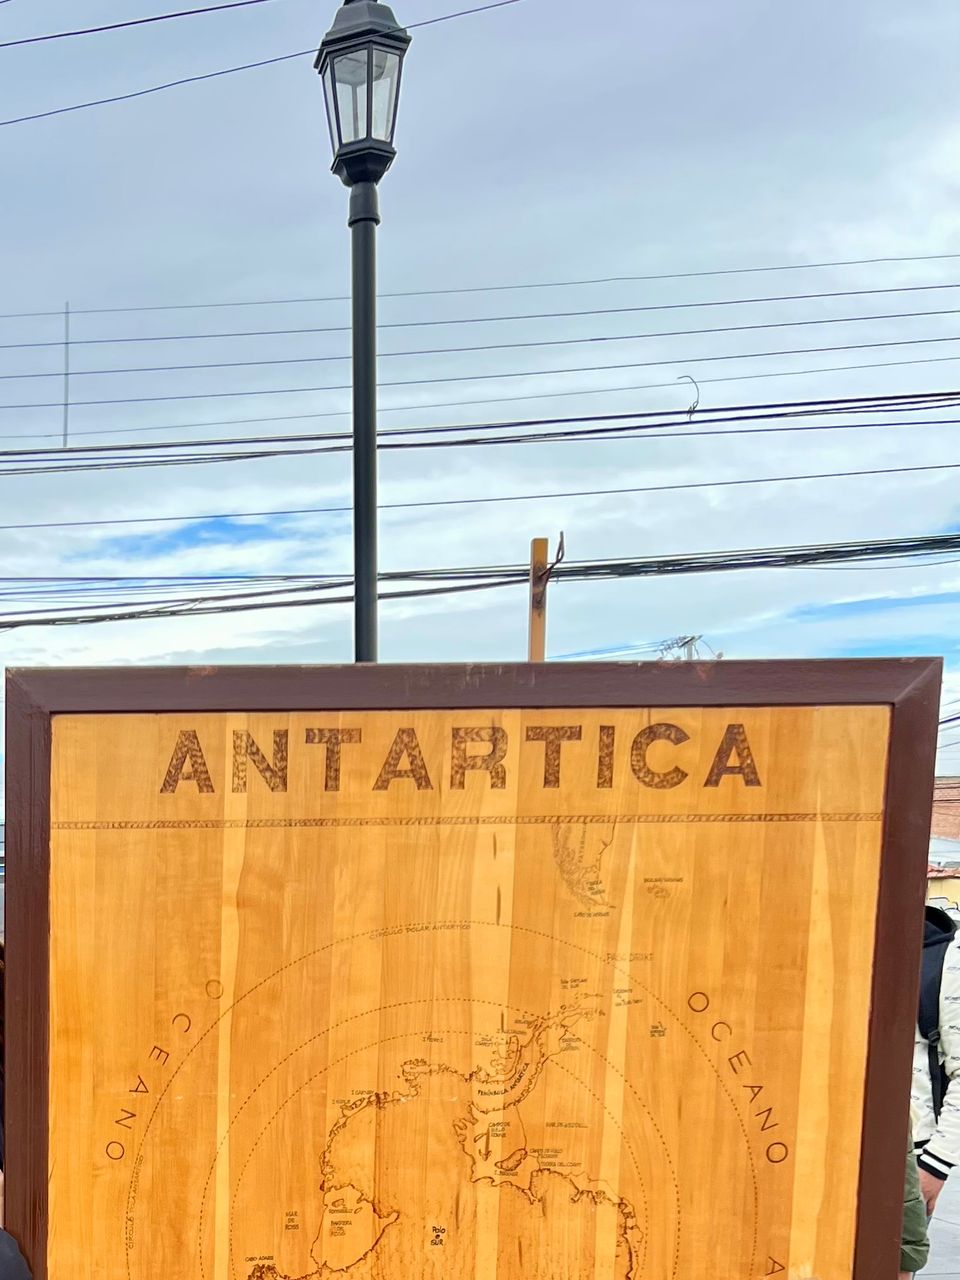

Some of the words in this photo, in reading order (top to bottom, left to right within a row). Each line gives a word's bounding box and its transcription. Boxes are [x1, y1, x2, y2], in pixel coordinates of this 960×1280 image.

[159, 723, 762, 793] ANTARTICA
[105, 979, 224, 1161] OCEANO
[687, 991, 789, 1164] OCEANO
